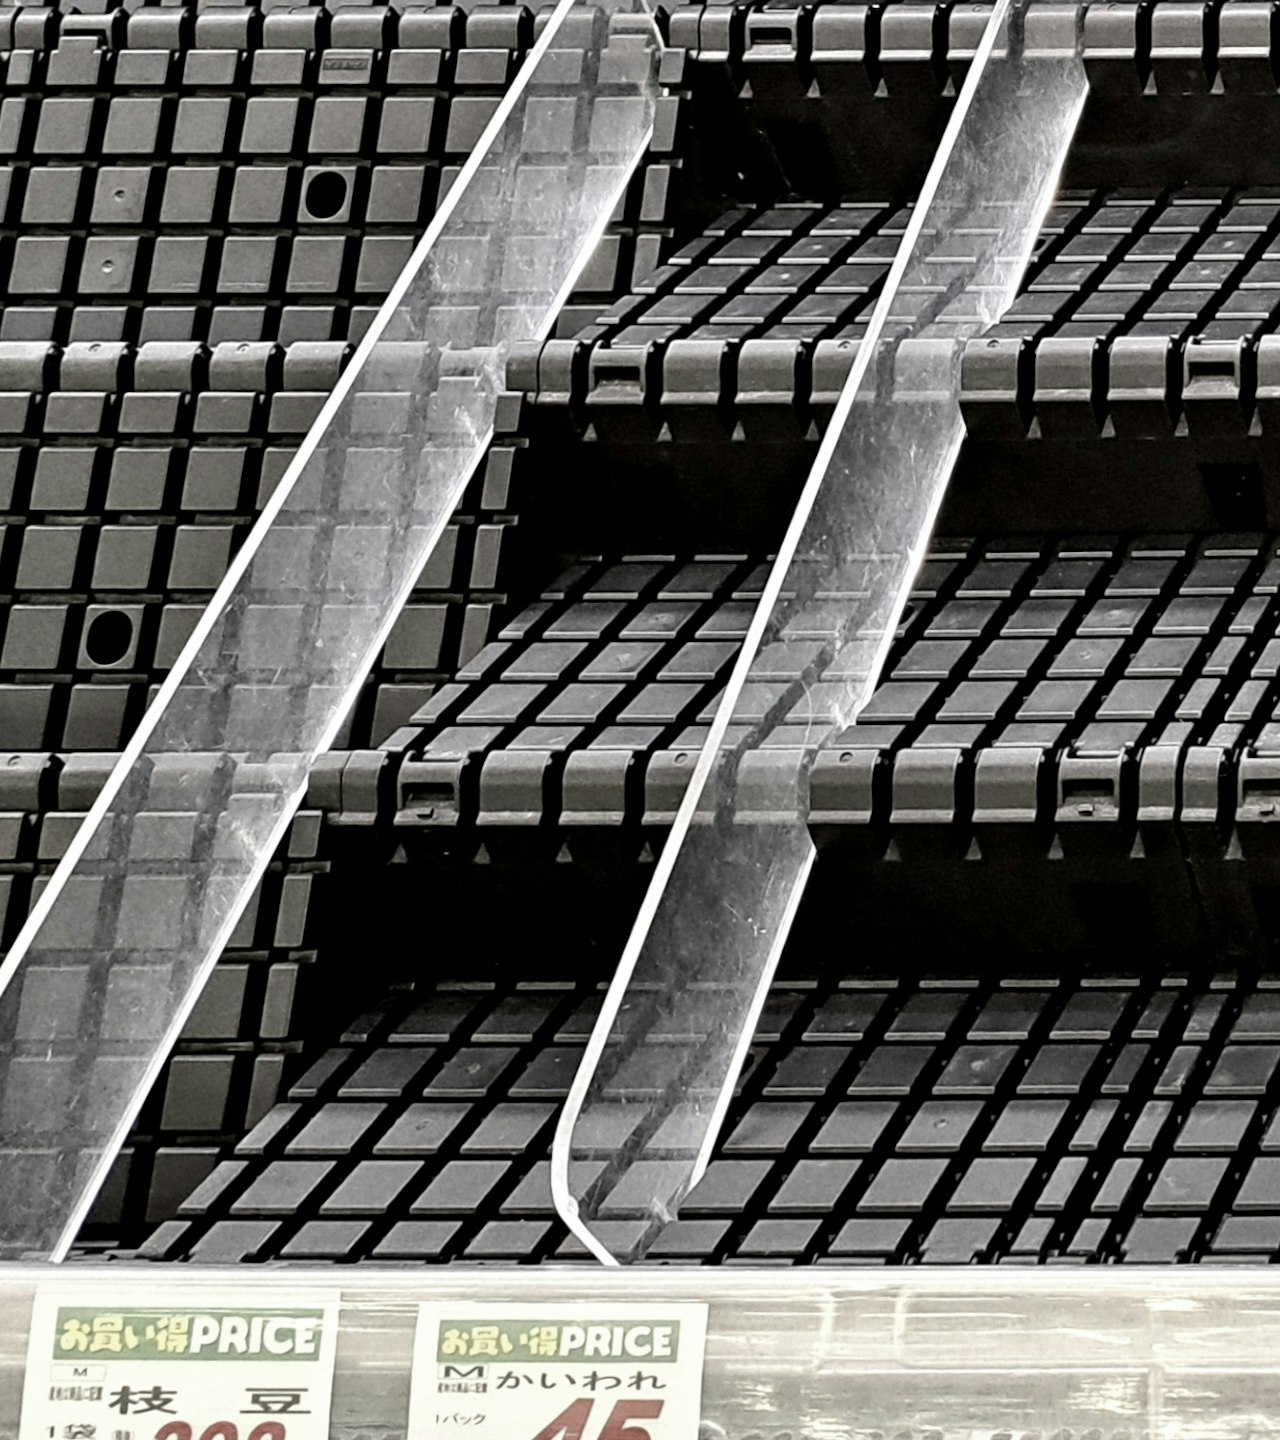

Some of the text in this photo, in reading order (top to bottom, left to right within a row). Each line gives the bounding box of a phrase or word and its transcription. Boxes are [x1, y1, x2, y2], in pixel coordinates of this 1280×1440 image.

[60, 1314, 317, 1355] お買い得PRICE
[442, 1326, 673, 1357] お買い得PRICE
[496, 1371, 667, 1392] かいわれ
